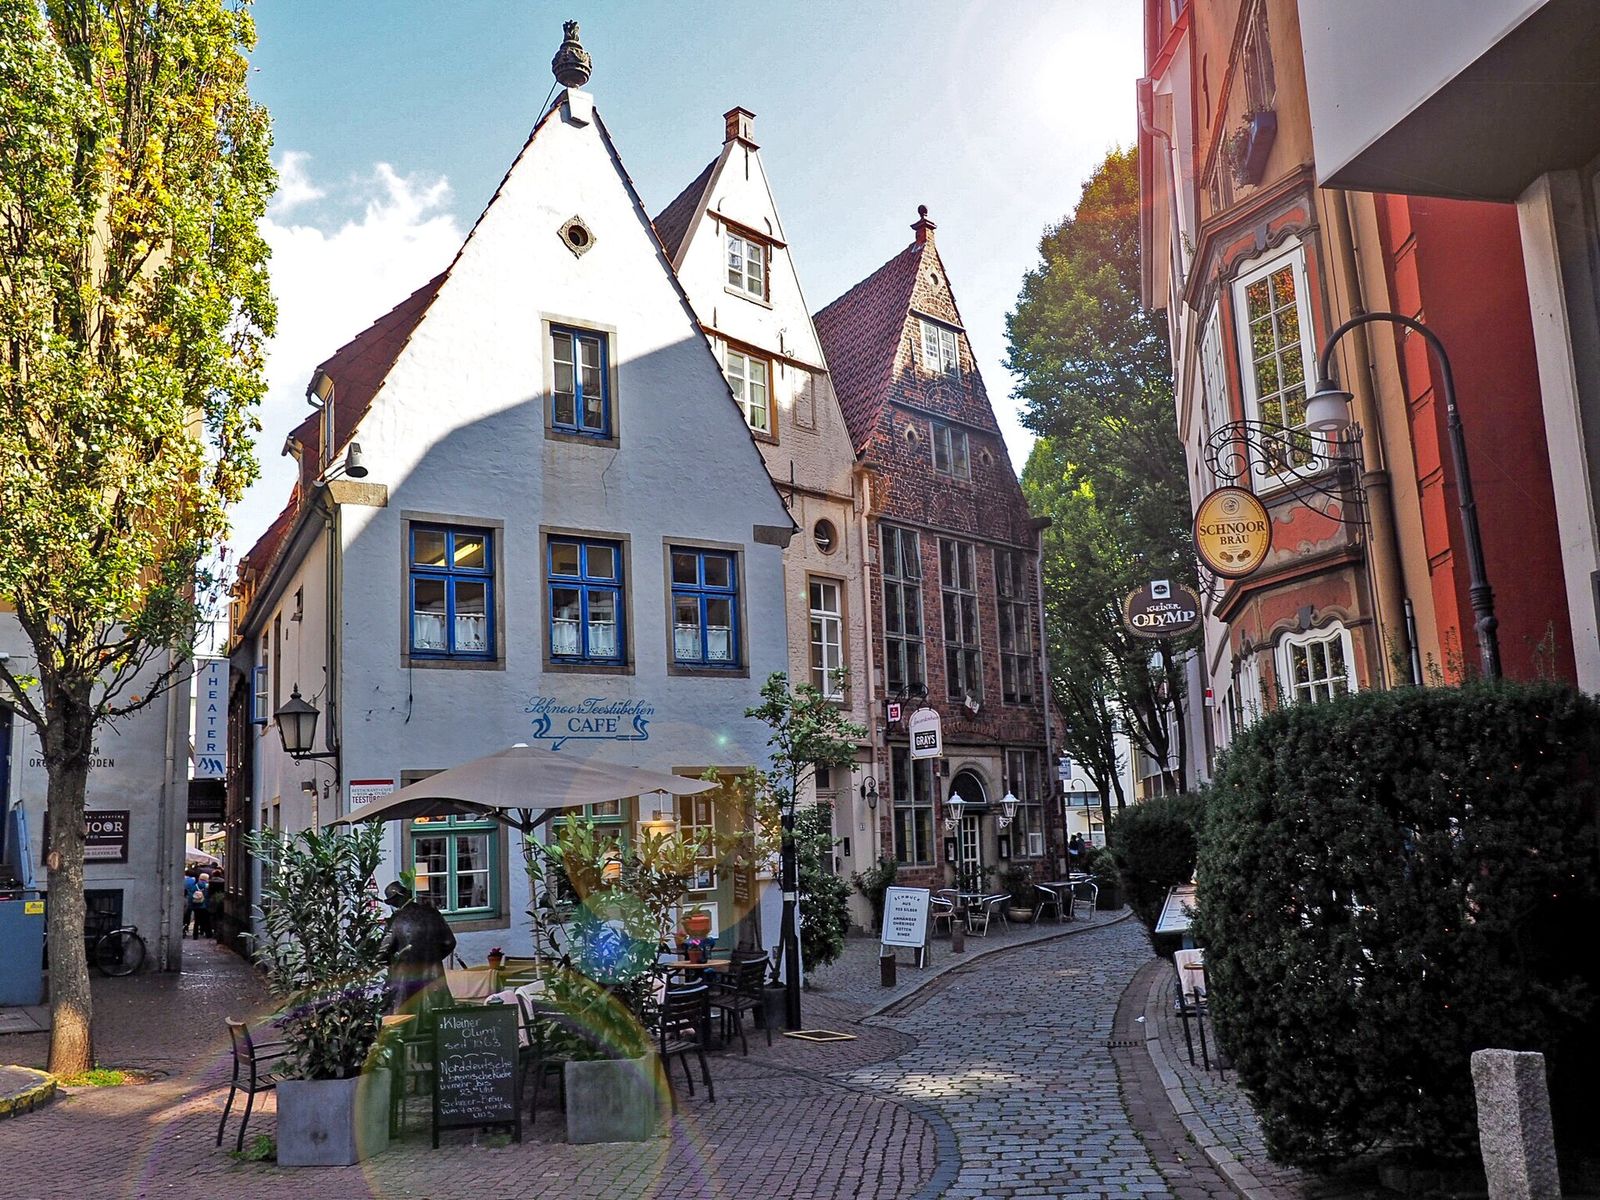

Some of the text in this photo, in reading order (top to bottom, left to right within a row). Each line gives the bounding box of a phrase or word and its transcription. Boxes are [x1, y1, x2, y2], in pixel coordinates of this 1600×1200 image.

[1199, 521, 1266, 537] SCHNOOR
[1220, 533, 1250, 545] BRÄU
[206, 663, 219, 752] THEATER
[915, 734, 936, 746] GRAYS
[88, 758, 115, 768] ODEN
